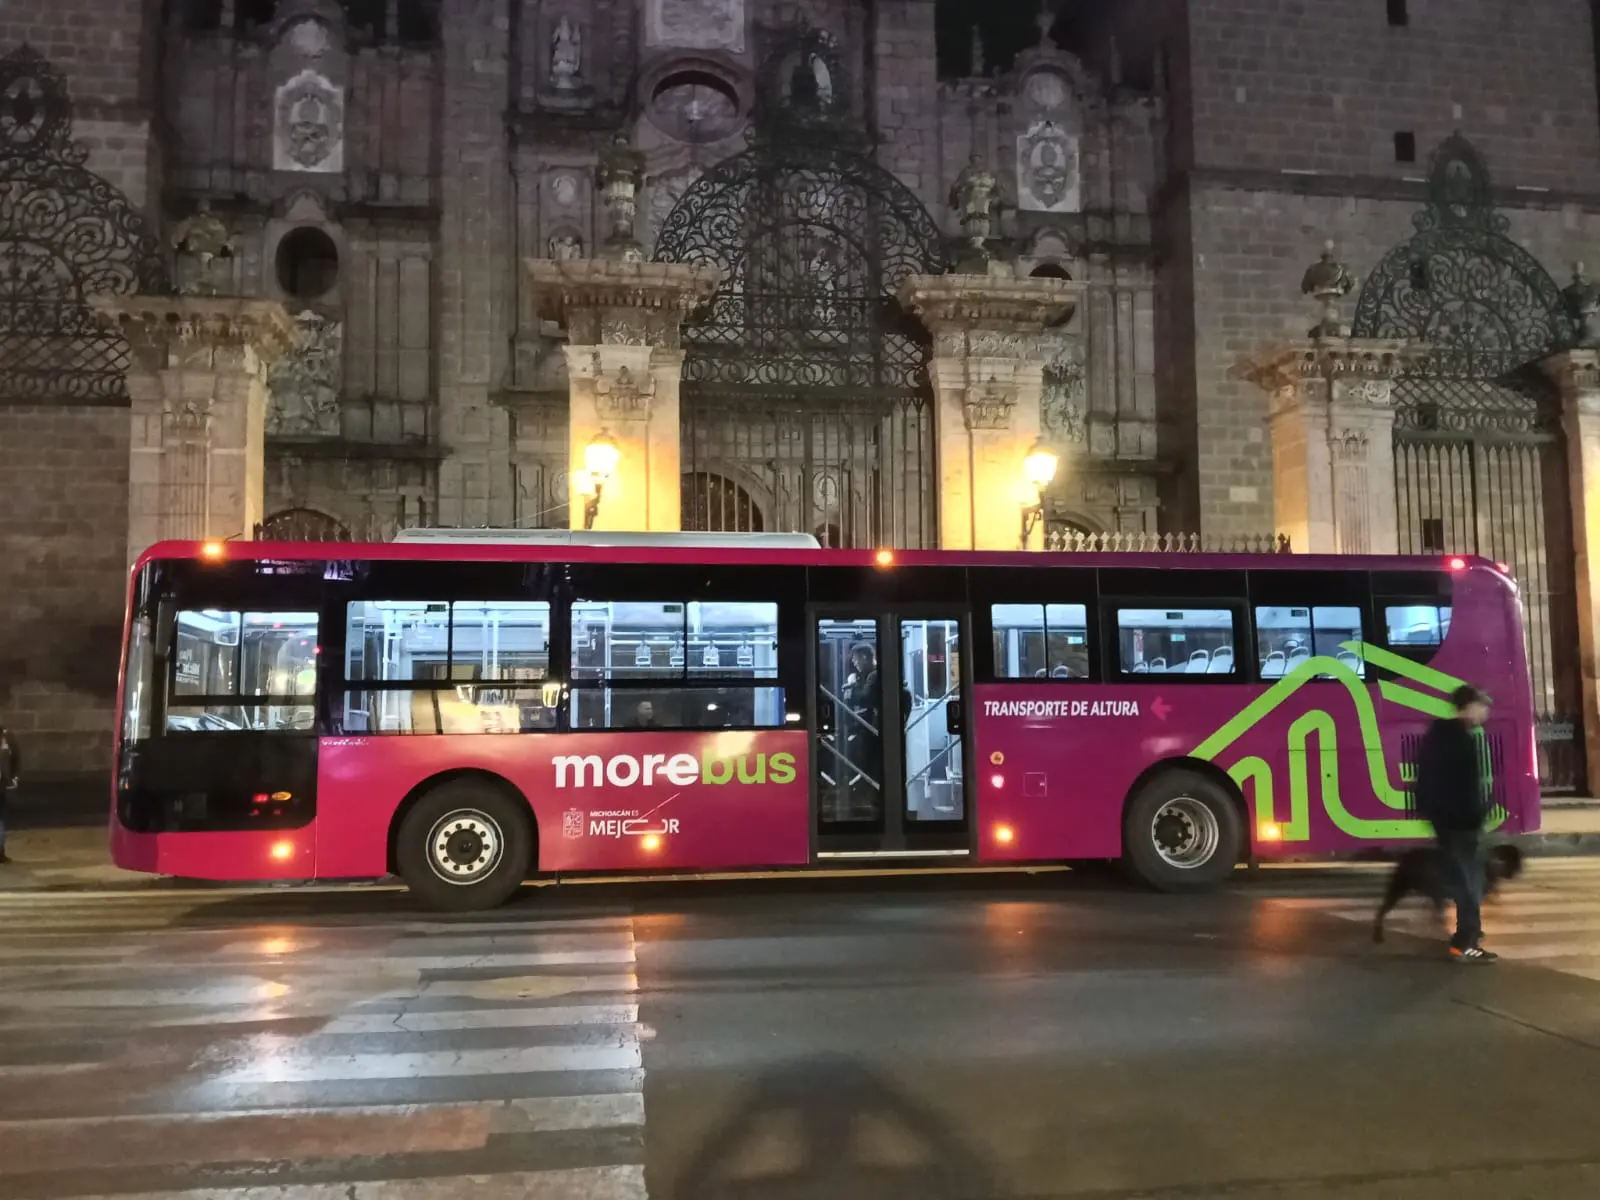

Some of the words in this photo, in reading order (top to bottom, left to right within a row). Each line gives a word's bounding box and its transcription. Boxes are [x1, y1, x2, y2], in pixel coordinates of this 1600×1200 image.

[984, 701, 1067, 716] TRANSPORTE
[1070, 701, 1088, 716] DE
[1090, 701, 1139, 716] ALTURA
[552, 746, 796, 787] morebus
